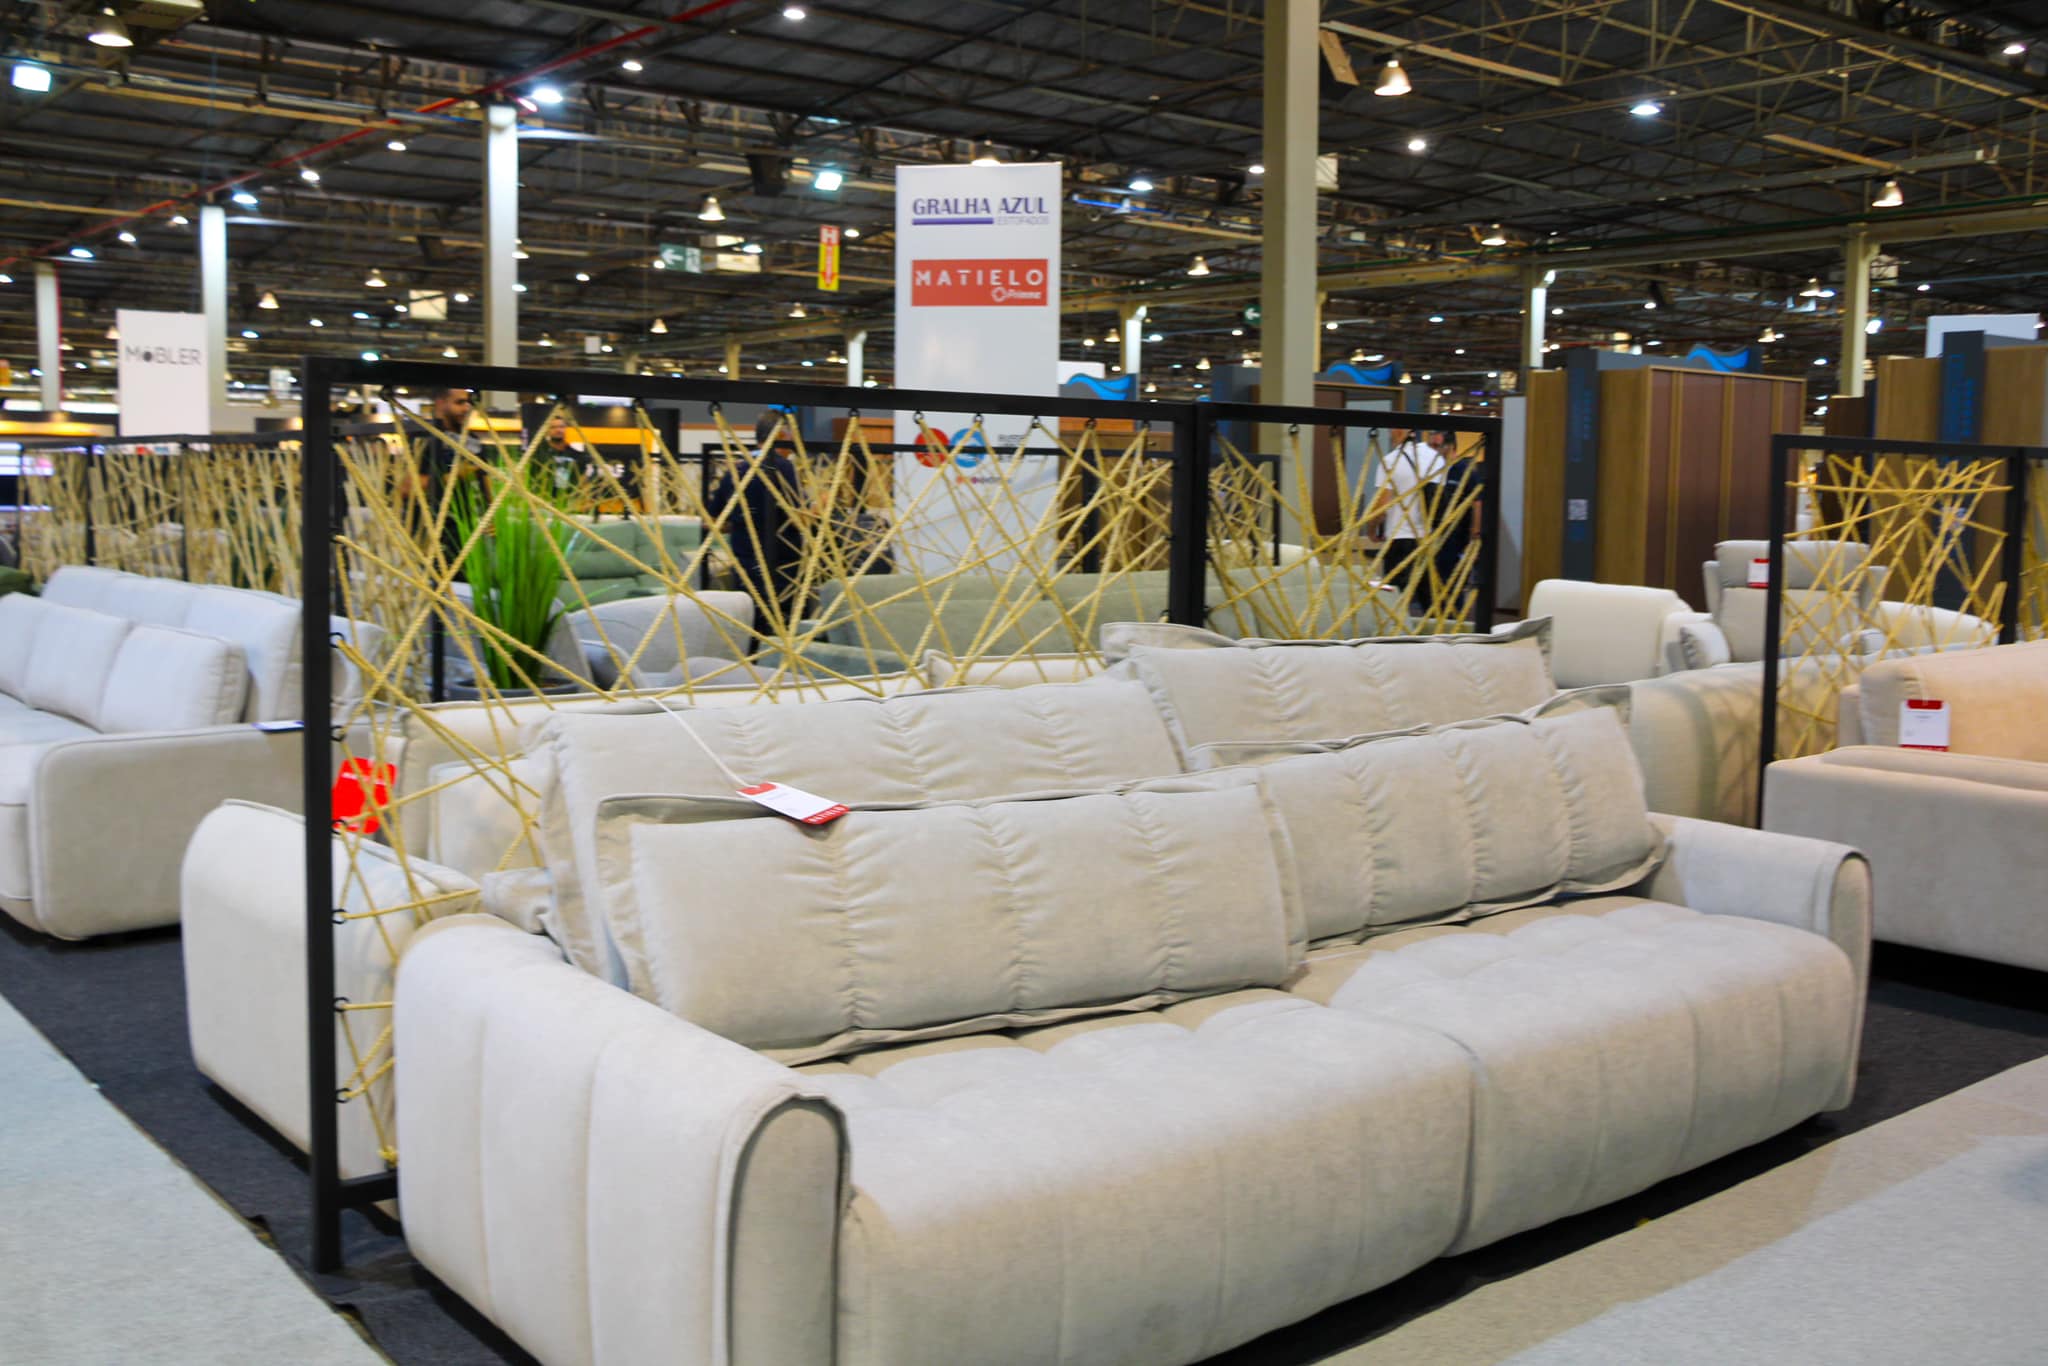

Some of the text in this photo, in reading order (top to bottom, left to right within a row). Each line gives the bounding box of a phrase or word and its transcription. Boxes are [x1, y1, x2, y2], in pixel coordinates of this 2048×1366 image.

[913, 197, 1049, 215] GRALHA AZUL
[821, 229, 839, 244] H
[915, 269, 1044, 286] MATIELO
